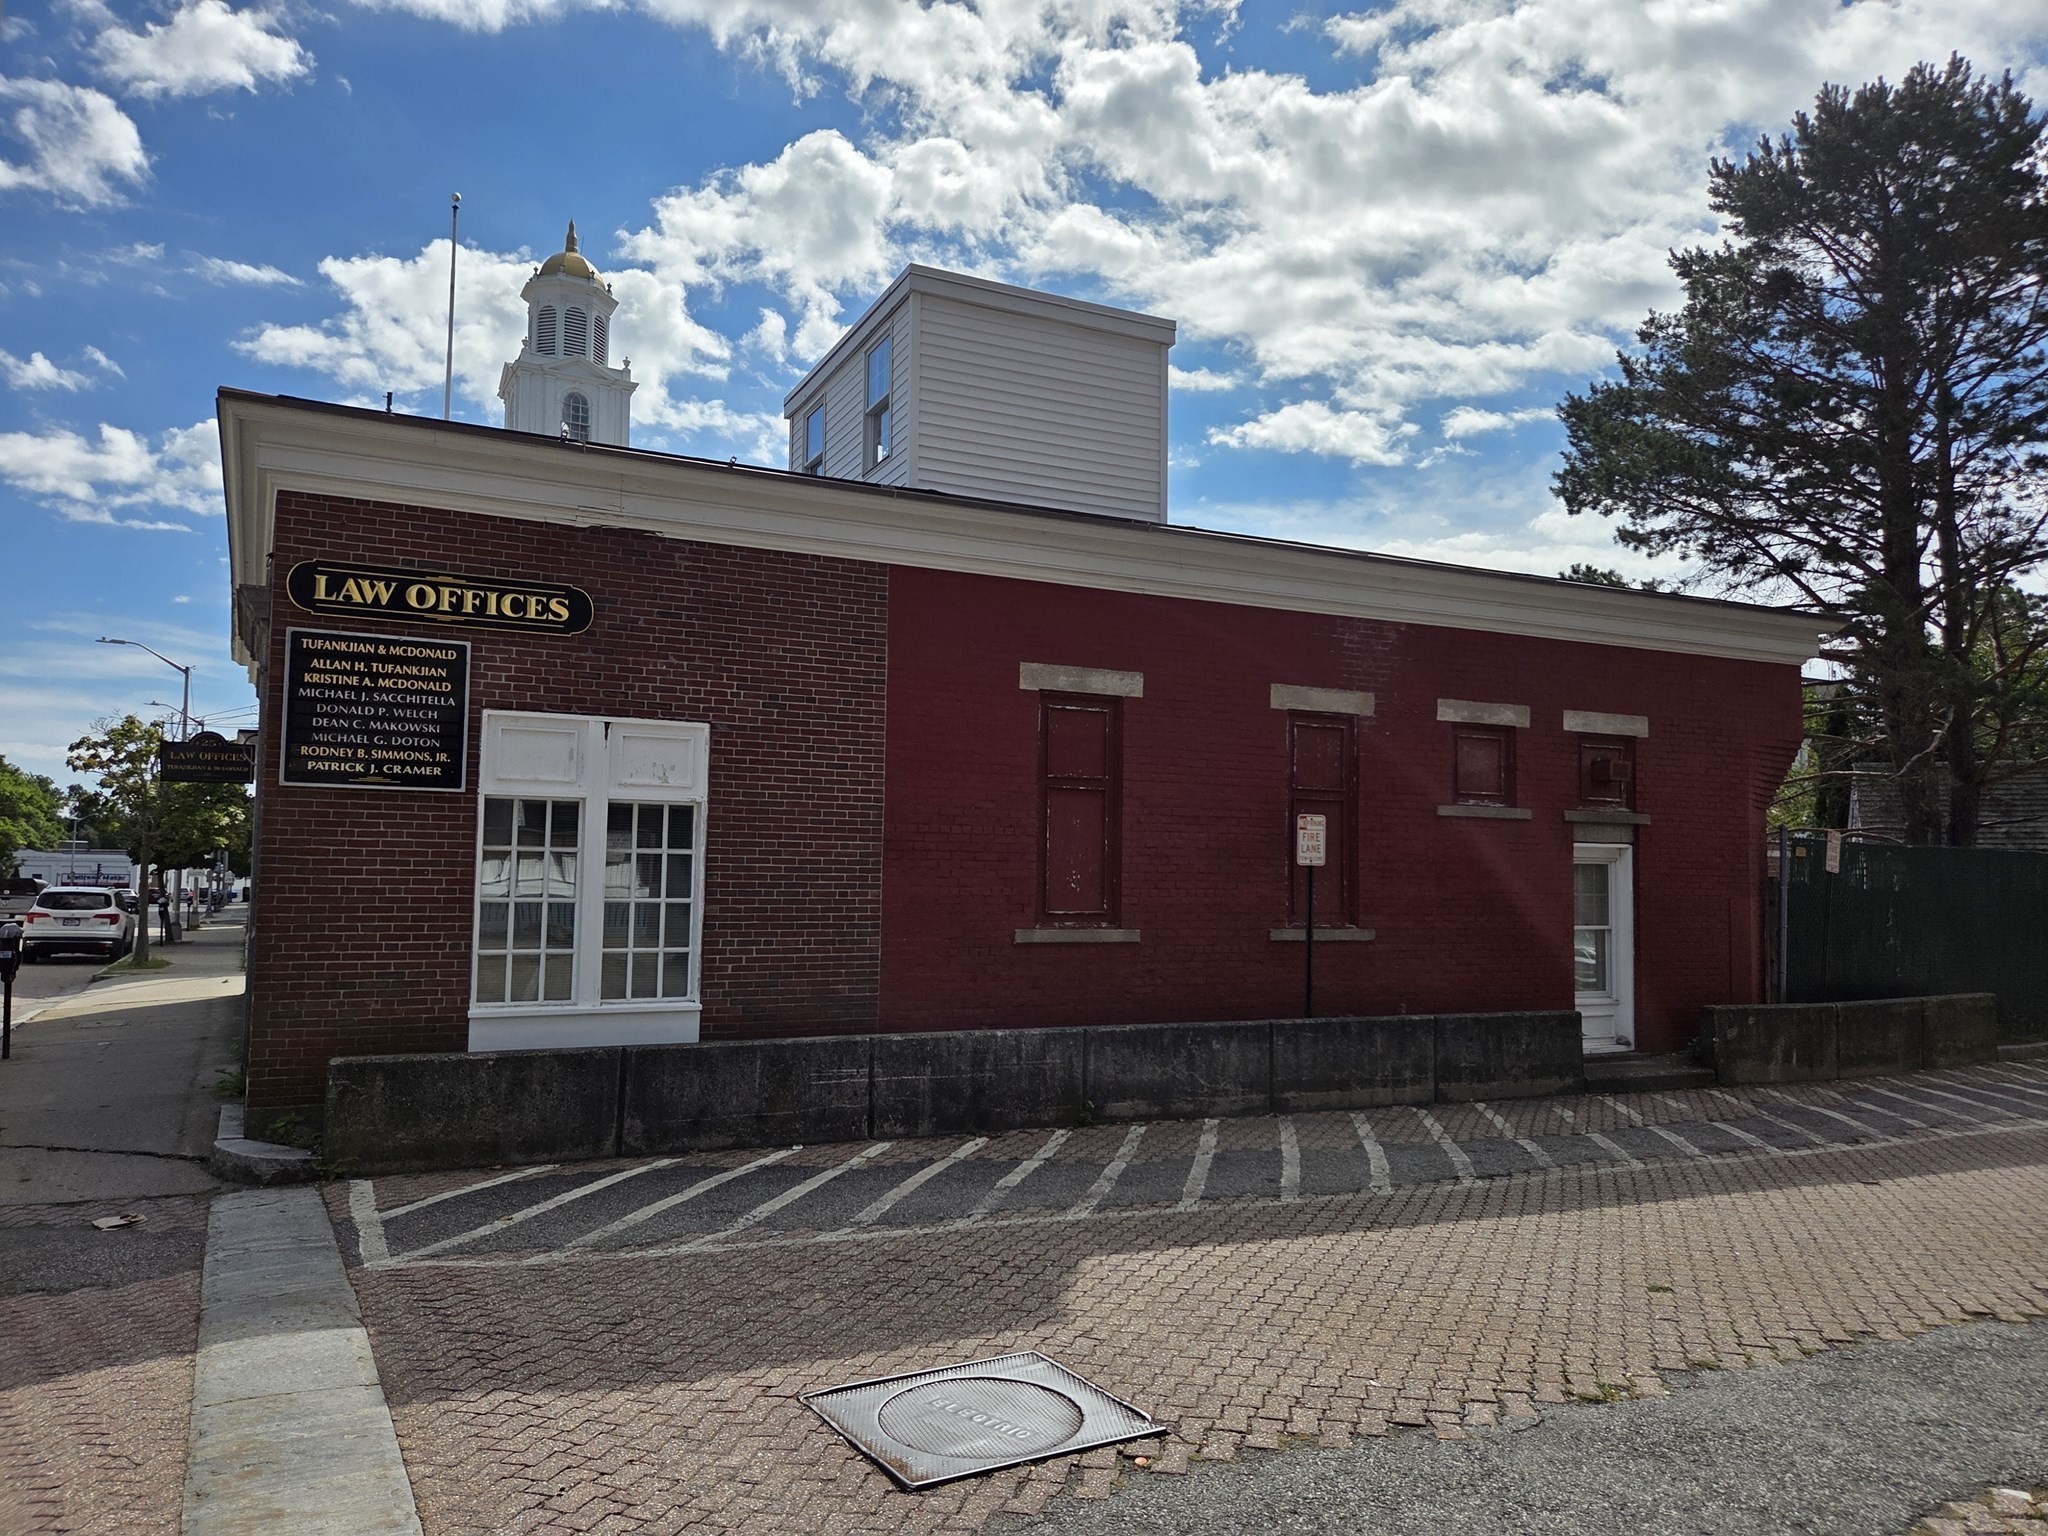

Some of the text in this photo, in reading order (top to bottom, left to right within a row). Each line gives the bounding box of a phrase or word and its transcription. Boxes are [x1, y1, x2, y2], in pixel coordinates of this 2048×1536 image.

[313, 574, 570, 622] LAW OFFICES
[301, 638, 457, 660] TUFANKJIAN & MCDONALD
[310, 658, 447, 677] ALLAN H. TUFANKJIAN
[304, 672, 452, 692] KRISTINE A. MCDONALD
[298, 687, 456, 707] MICHAEL J. SACCHITELLA
[316, 703, 438, 719] DONALD P. WELCH
[312, 717, 440, 733] DEAN C. MAKOWSKI
[311, 732, 440, 748] MICHAEL G. DOTON
[169, 751, 247, 762] LAW OFFICES
[300, 745, 354, 757] RODNEY
[357, 748, 368, 758] B.
[435, 752, 451, 762] JR.
[307, 760, 442, 776] PATRICK J. CRAMER
[1302, 832, 1321, 842] FIRE
[1301, 844, 1322, 854] LANE
[930, 1397, 1031, 1438] ELECTRIC
